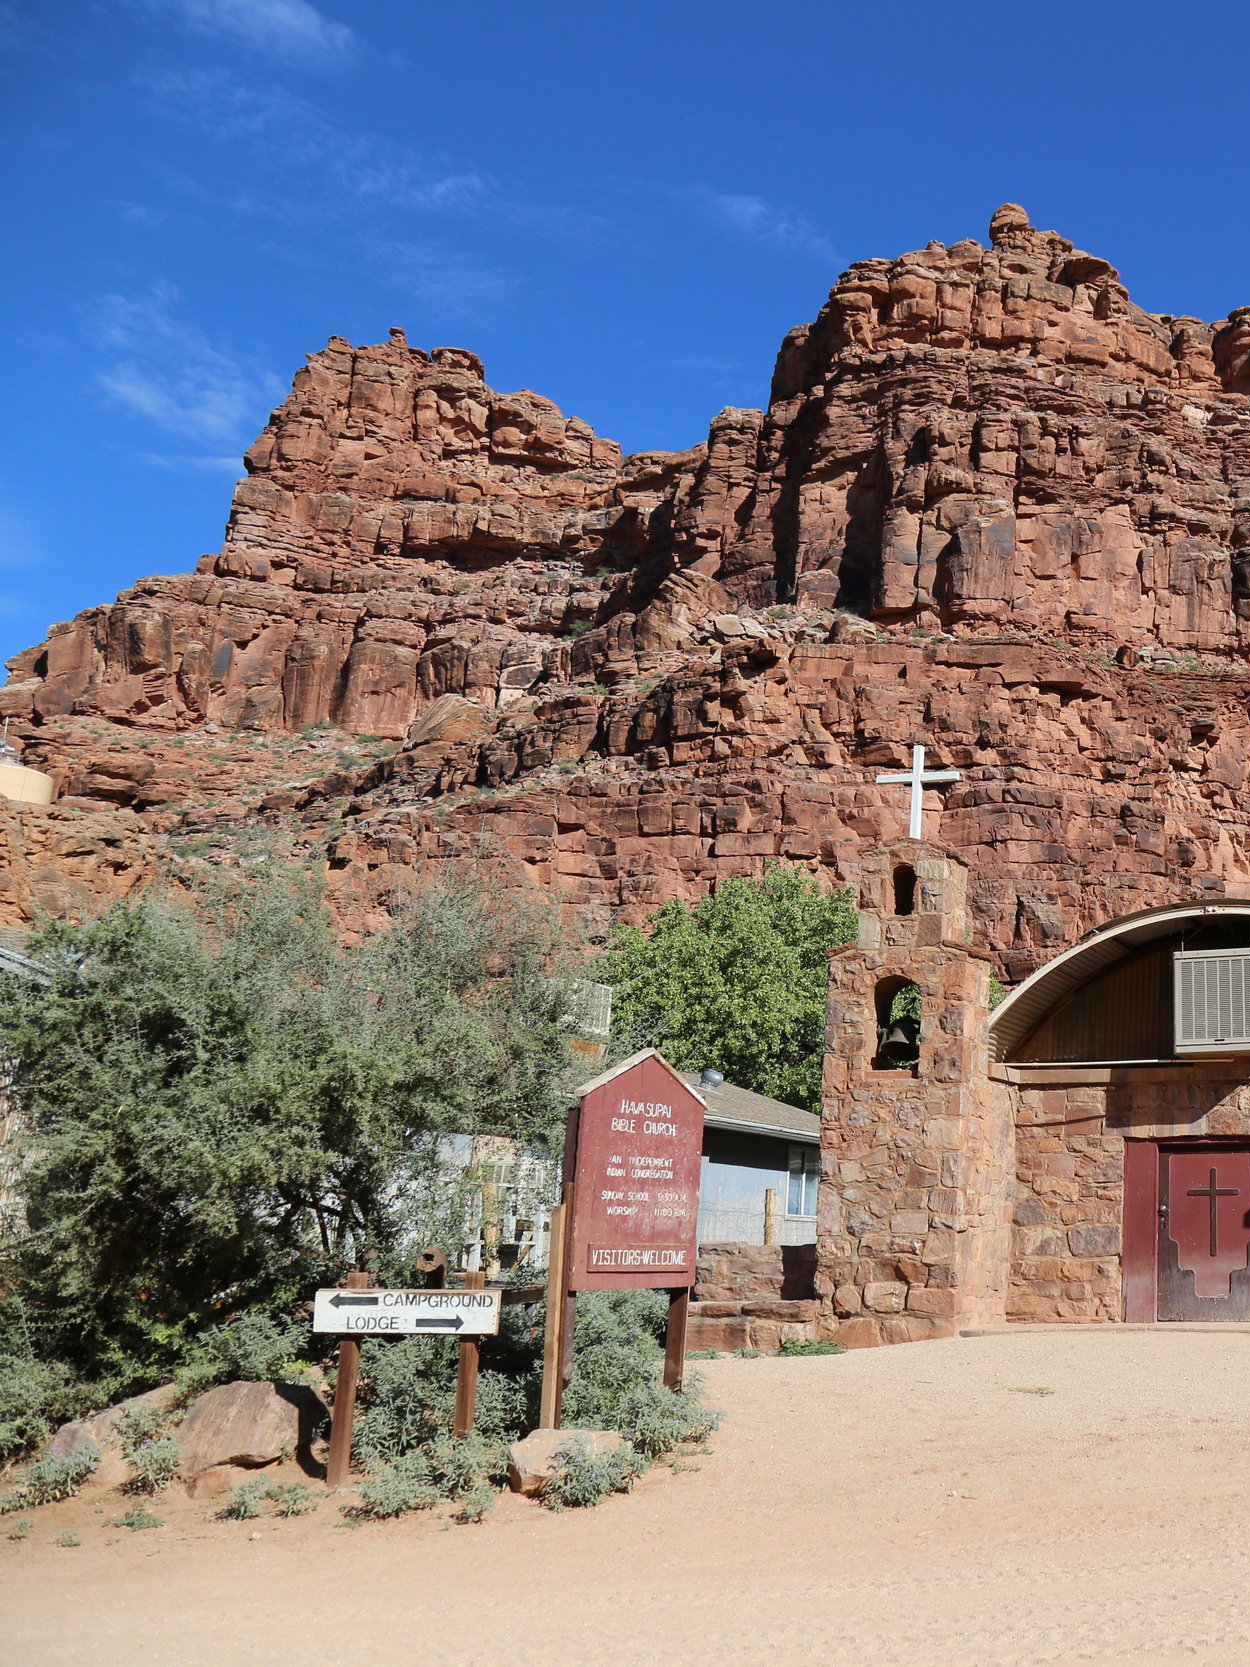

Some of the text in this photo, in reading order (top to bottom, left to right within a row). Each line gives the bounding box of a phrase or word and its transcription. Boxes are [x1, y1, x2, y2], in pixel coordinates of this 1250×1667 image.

[611, 1117, 676, 1136] BIBLE CHURCH
[611, 1155, 673, 1167] AN INDEPENDENT
[631, 1169, 674, 1179] CONGREGATION
[601, 1190, 624, 1201] SUNDAY
[627, 1192, 650, 1202] SCHOOL
[383, 1293, 493, 1308] CAMPGROUND
[346, 1316, 400, 1330] LODGE
